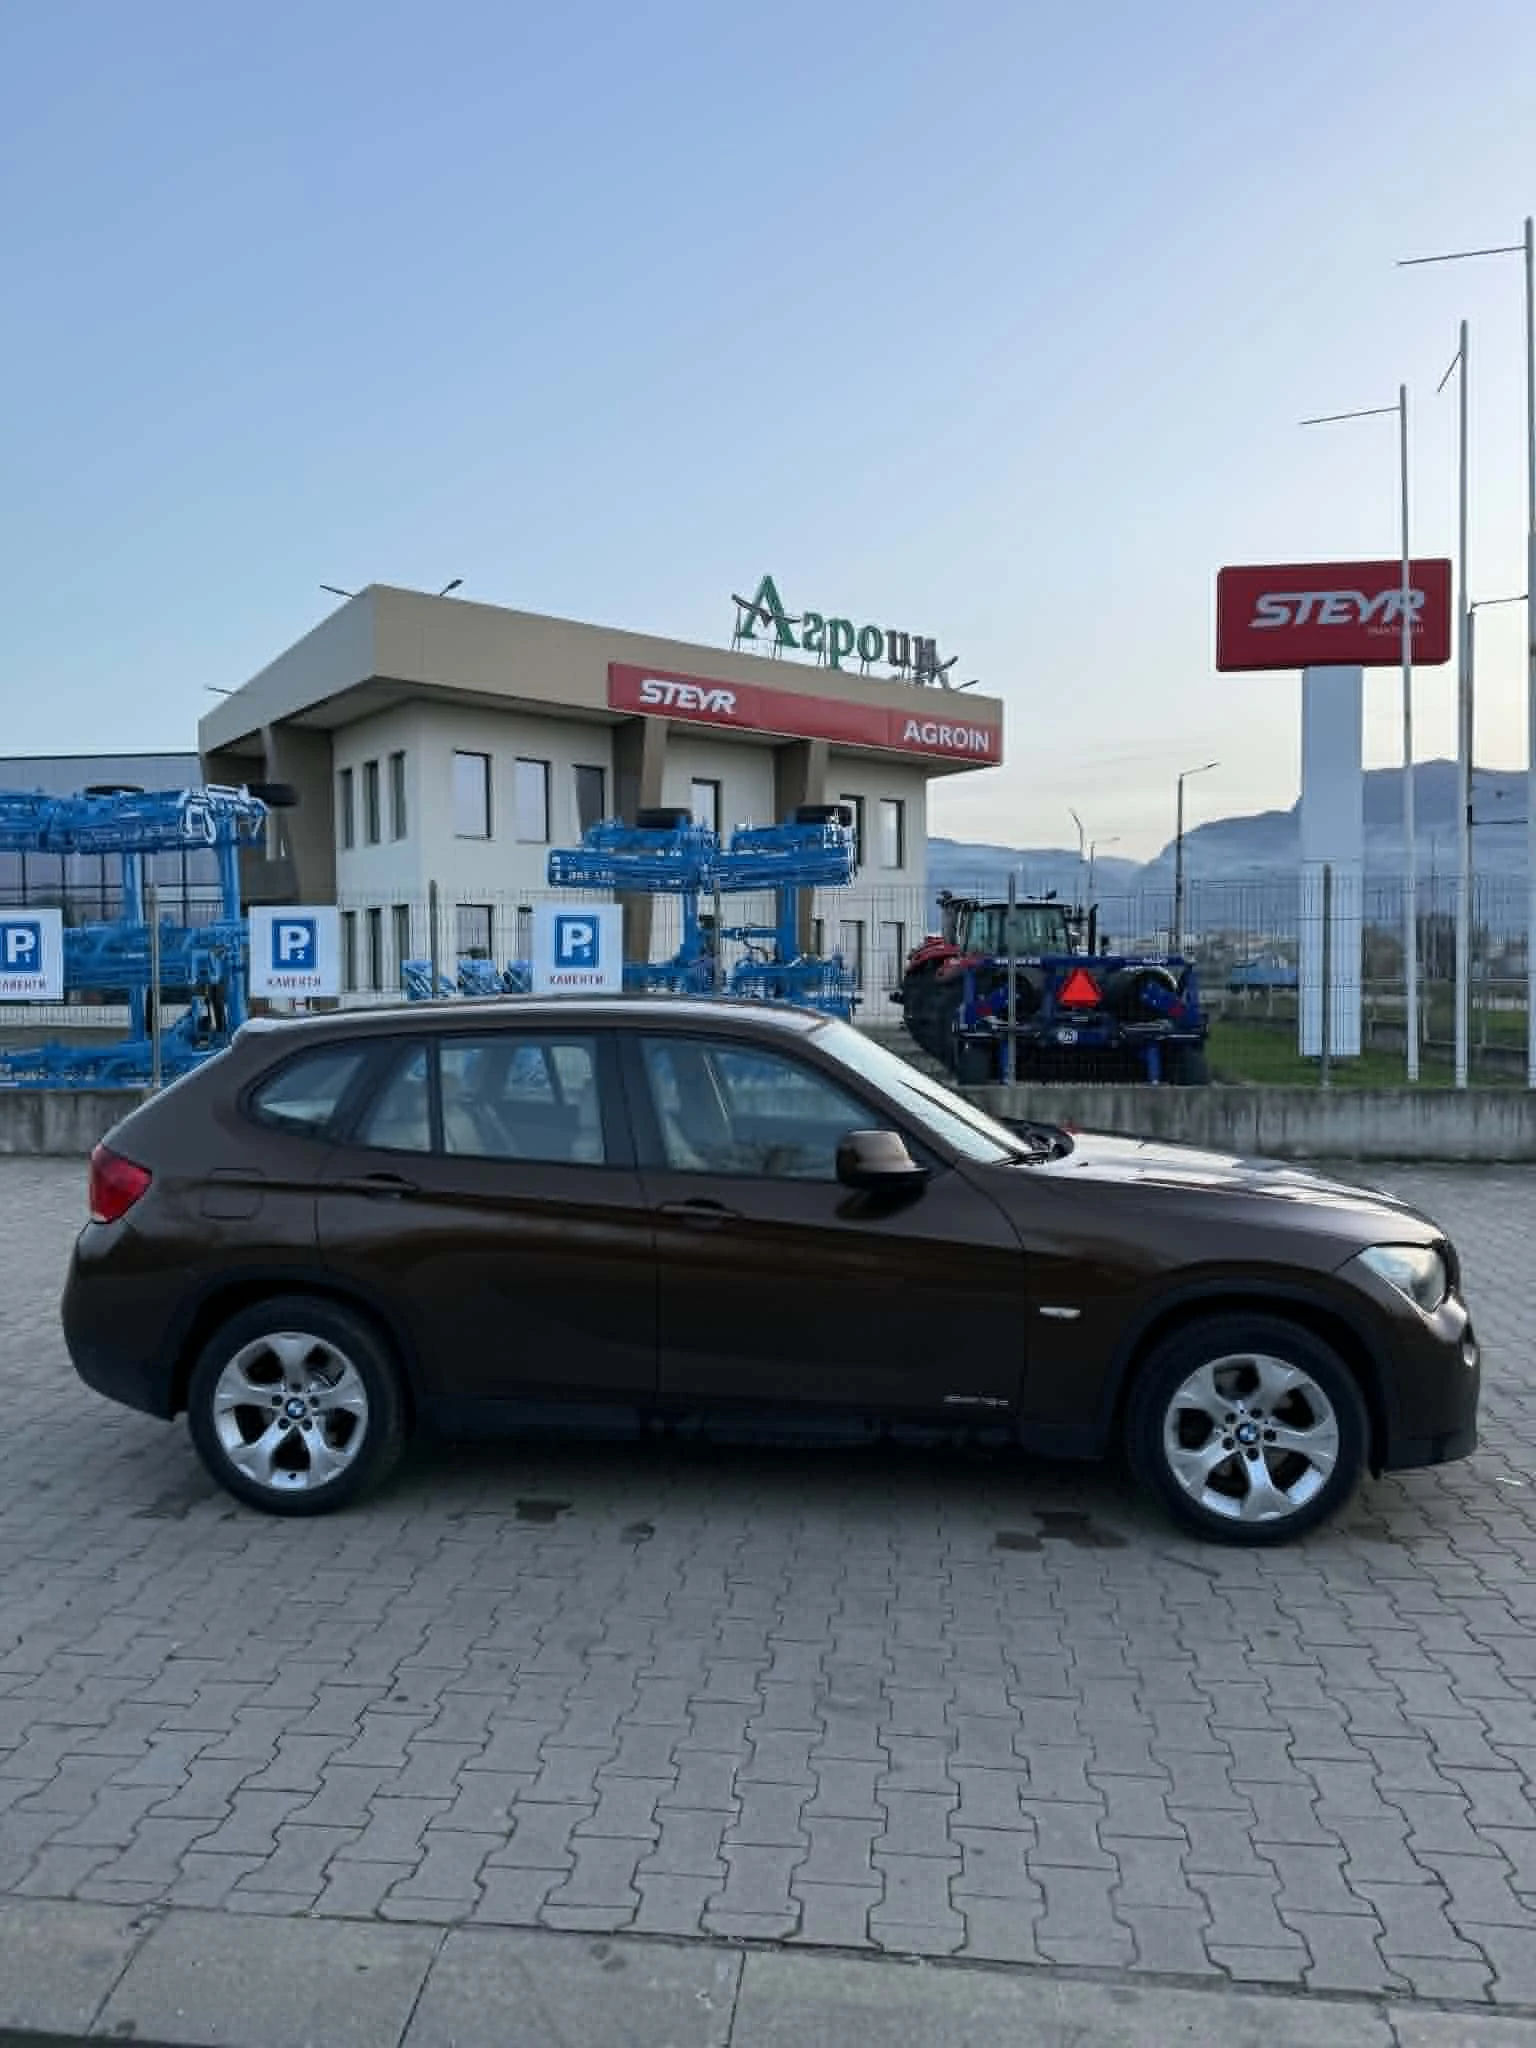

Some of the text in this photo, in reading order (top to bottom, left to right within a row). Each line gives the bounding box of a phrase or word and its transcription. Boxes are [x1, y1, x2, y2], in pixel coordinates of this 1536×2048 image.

[1249, 590, 1424, 627] STEYR
[640, 679, 737, 714] STEYR
[903, 719, 990, 753] AGROIN
